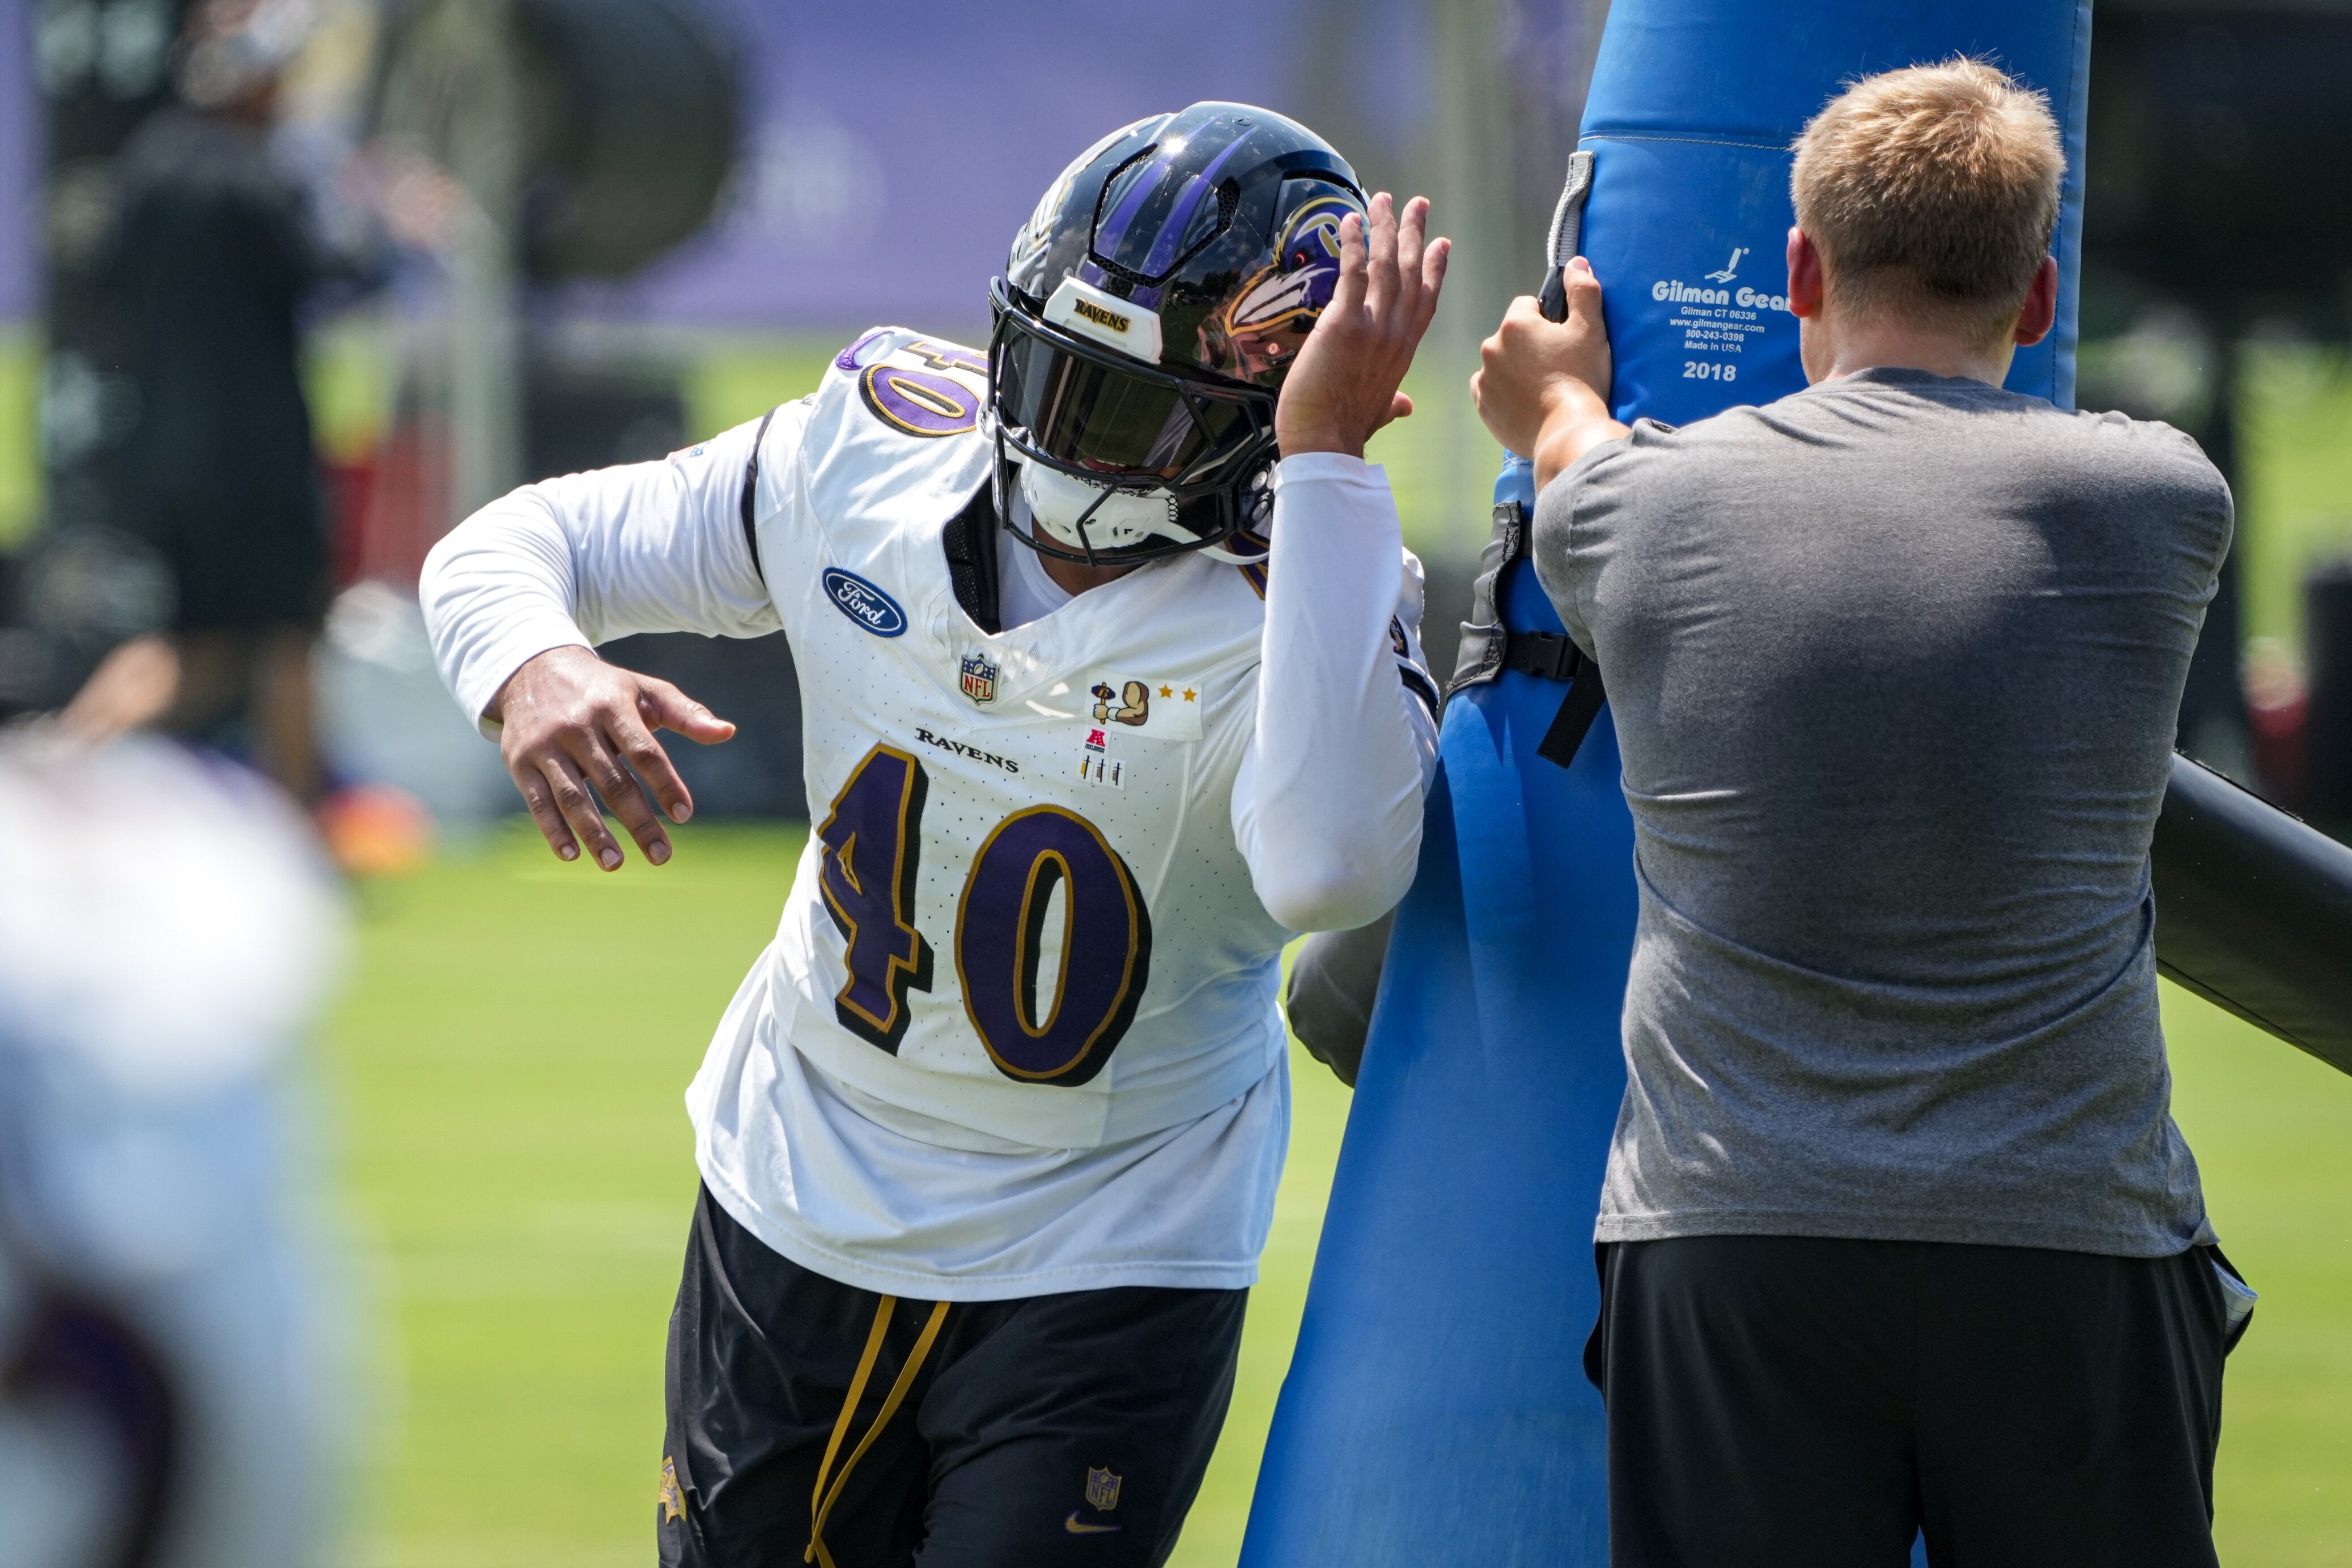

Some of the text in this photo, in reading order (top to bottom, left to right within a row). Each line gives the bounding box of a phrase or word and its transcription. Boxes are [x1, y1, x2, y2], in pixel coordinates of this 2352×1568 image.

[1652, 279, 1729, 305] Gilman
[1073, 297, 1130, 333] RAVENS
[1681, 306, 1756, 320] Gilman CT 06336
[1670, 318, 1765, 333] www.gilmangear.com
[1686, 329, 1744, 342] 800-243-0398
[1684, 340, 1742, 353] Made in USA
[1683, 361, 1737, 381] 2018
[837, 581, 886, 625] Ford
[963, 673, 991, 698] NFL
[915, 727, 1019, 773] RAVENS
[816, 742, 1151, 1087] 40
[1088, 1481, 1116, 1505] NFL
